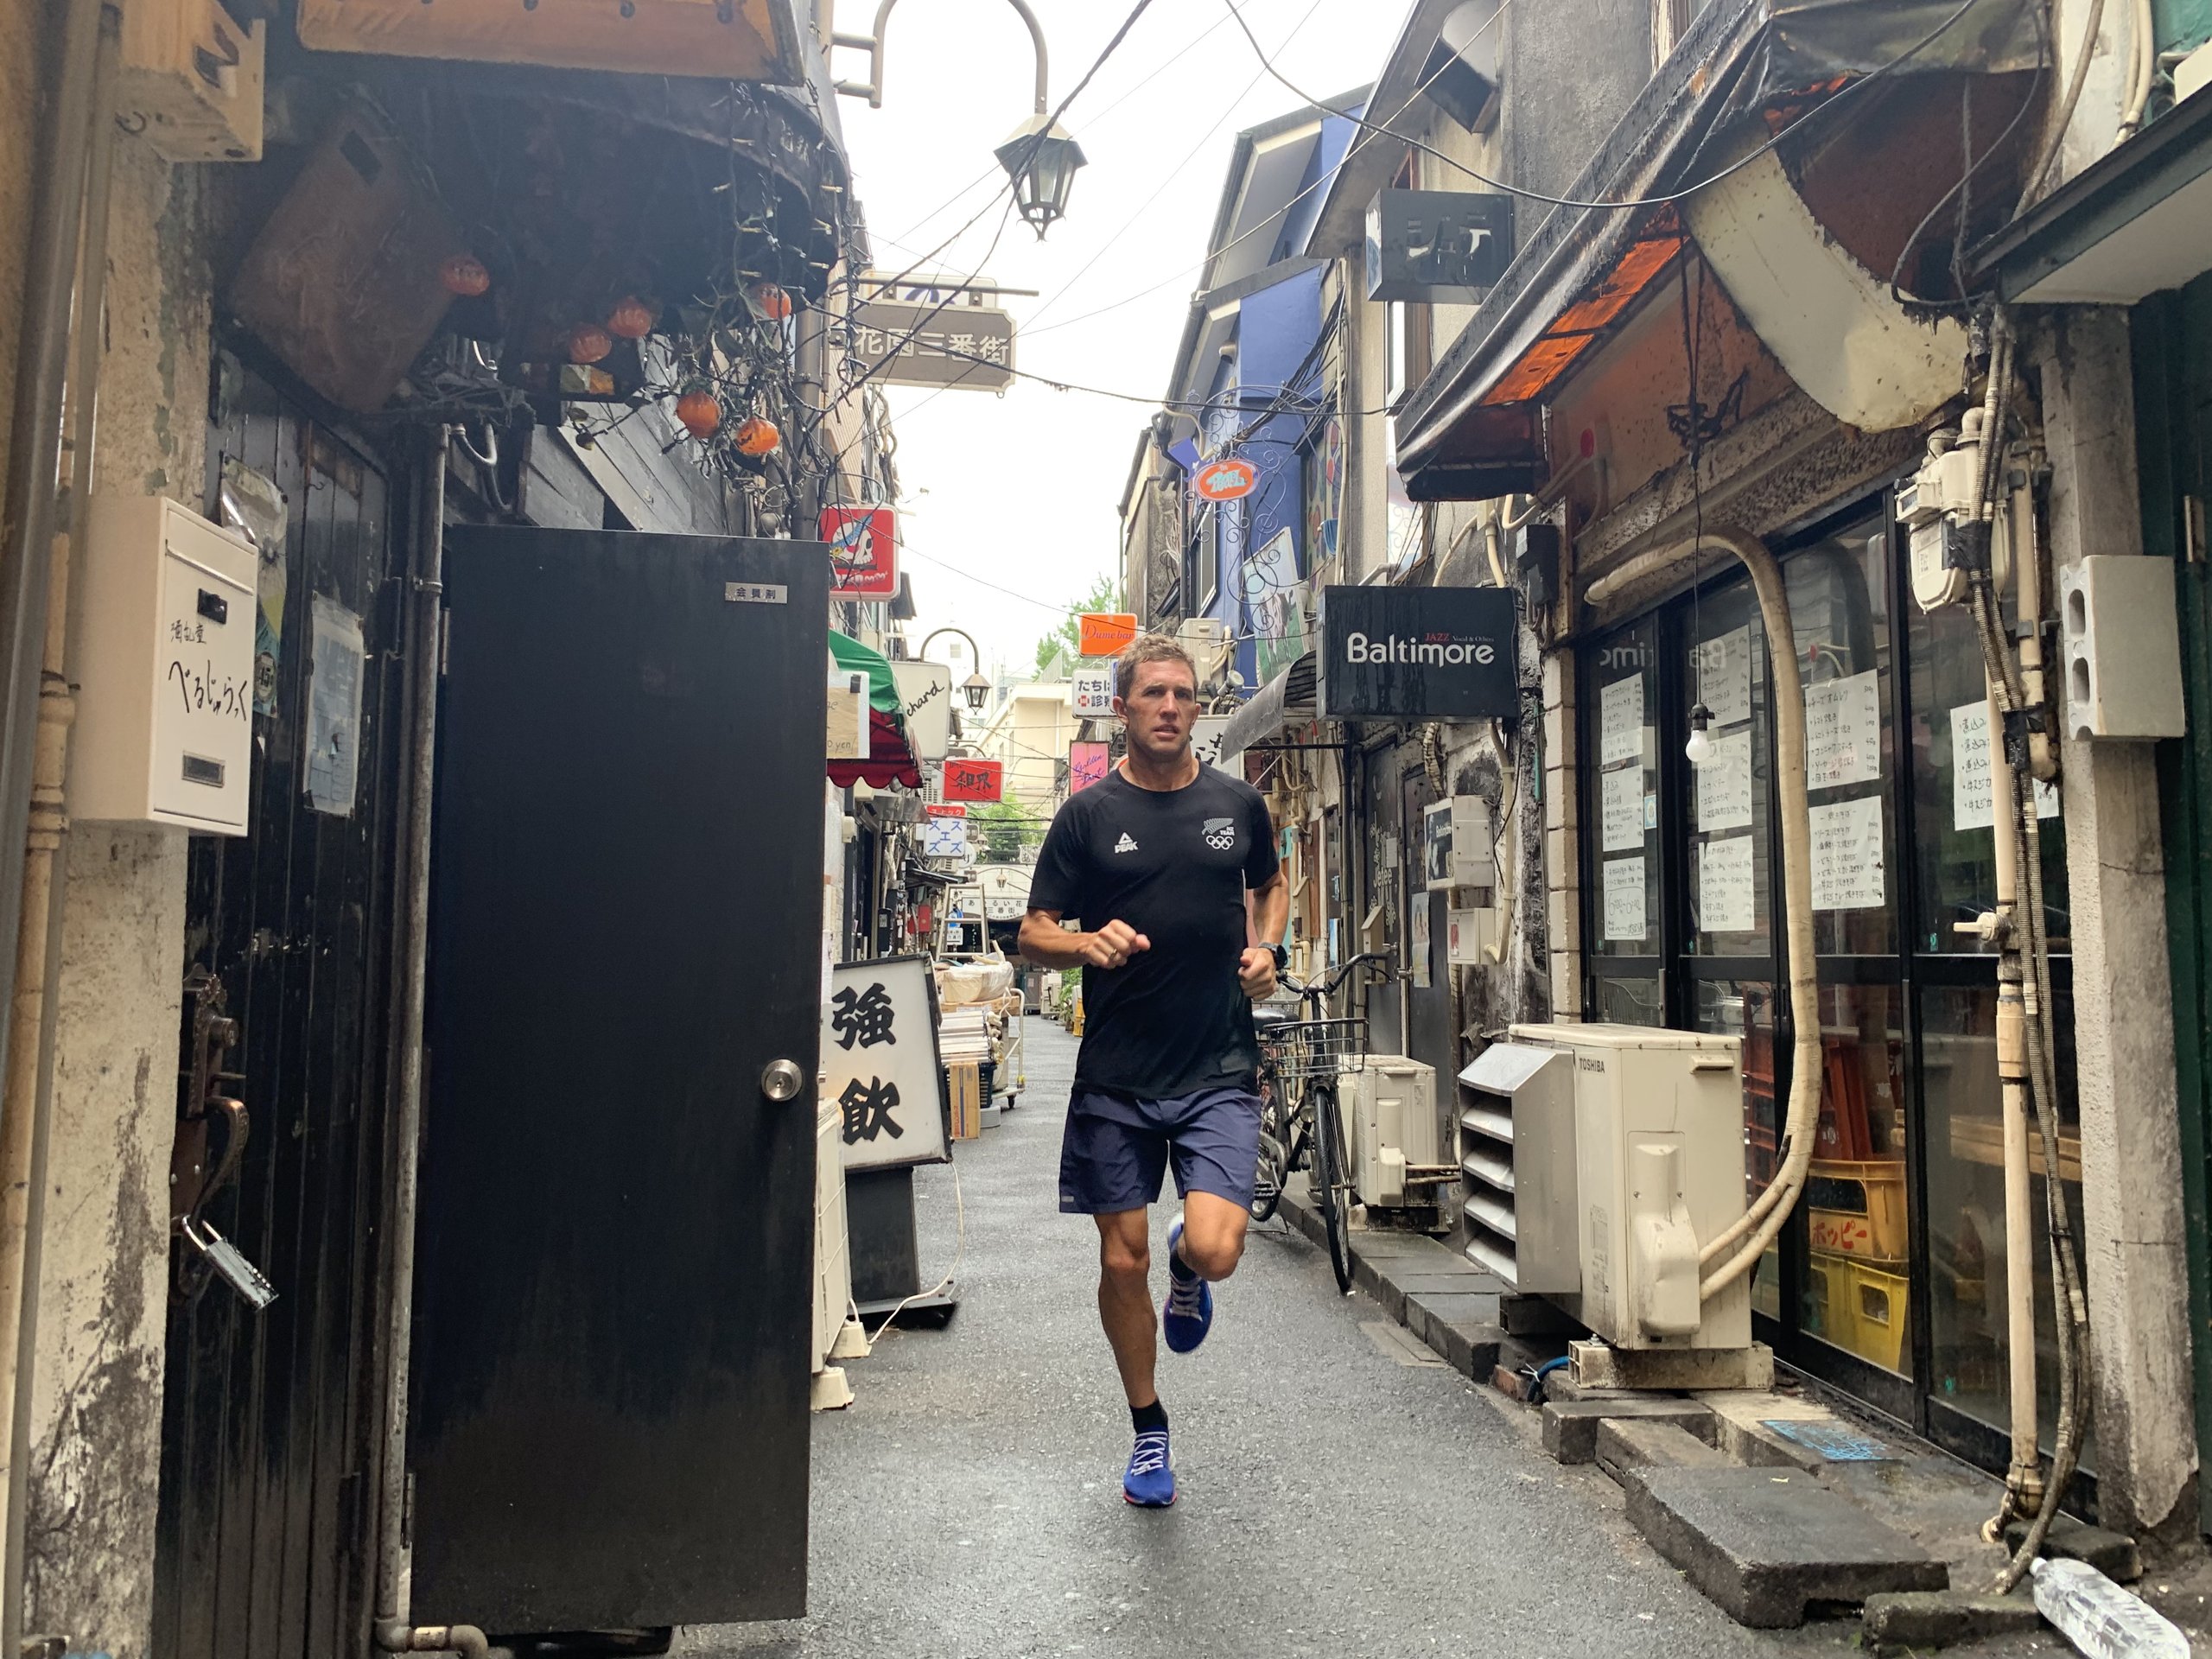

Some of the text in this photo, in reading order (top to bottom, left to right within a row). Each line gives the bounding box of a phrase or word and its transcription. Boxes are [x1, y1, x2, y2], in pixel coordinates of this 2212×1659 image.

[855, 326, 1009, 365] 花園三番街
[1347, 632, 1495, 669] Baltimore
[1425, 632, 1450, 642] JAZZ
[1114, 841, 1139, 854] PEAK
[832, 982, 904, 1146] 強飲
[1579, 1058, 1605, 1073] TOSHIBA
[1812, 1219, 1867, 1250] ホッピー
